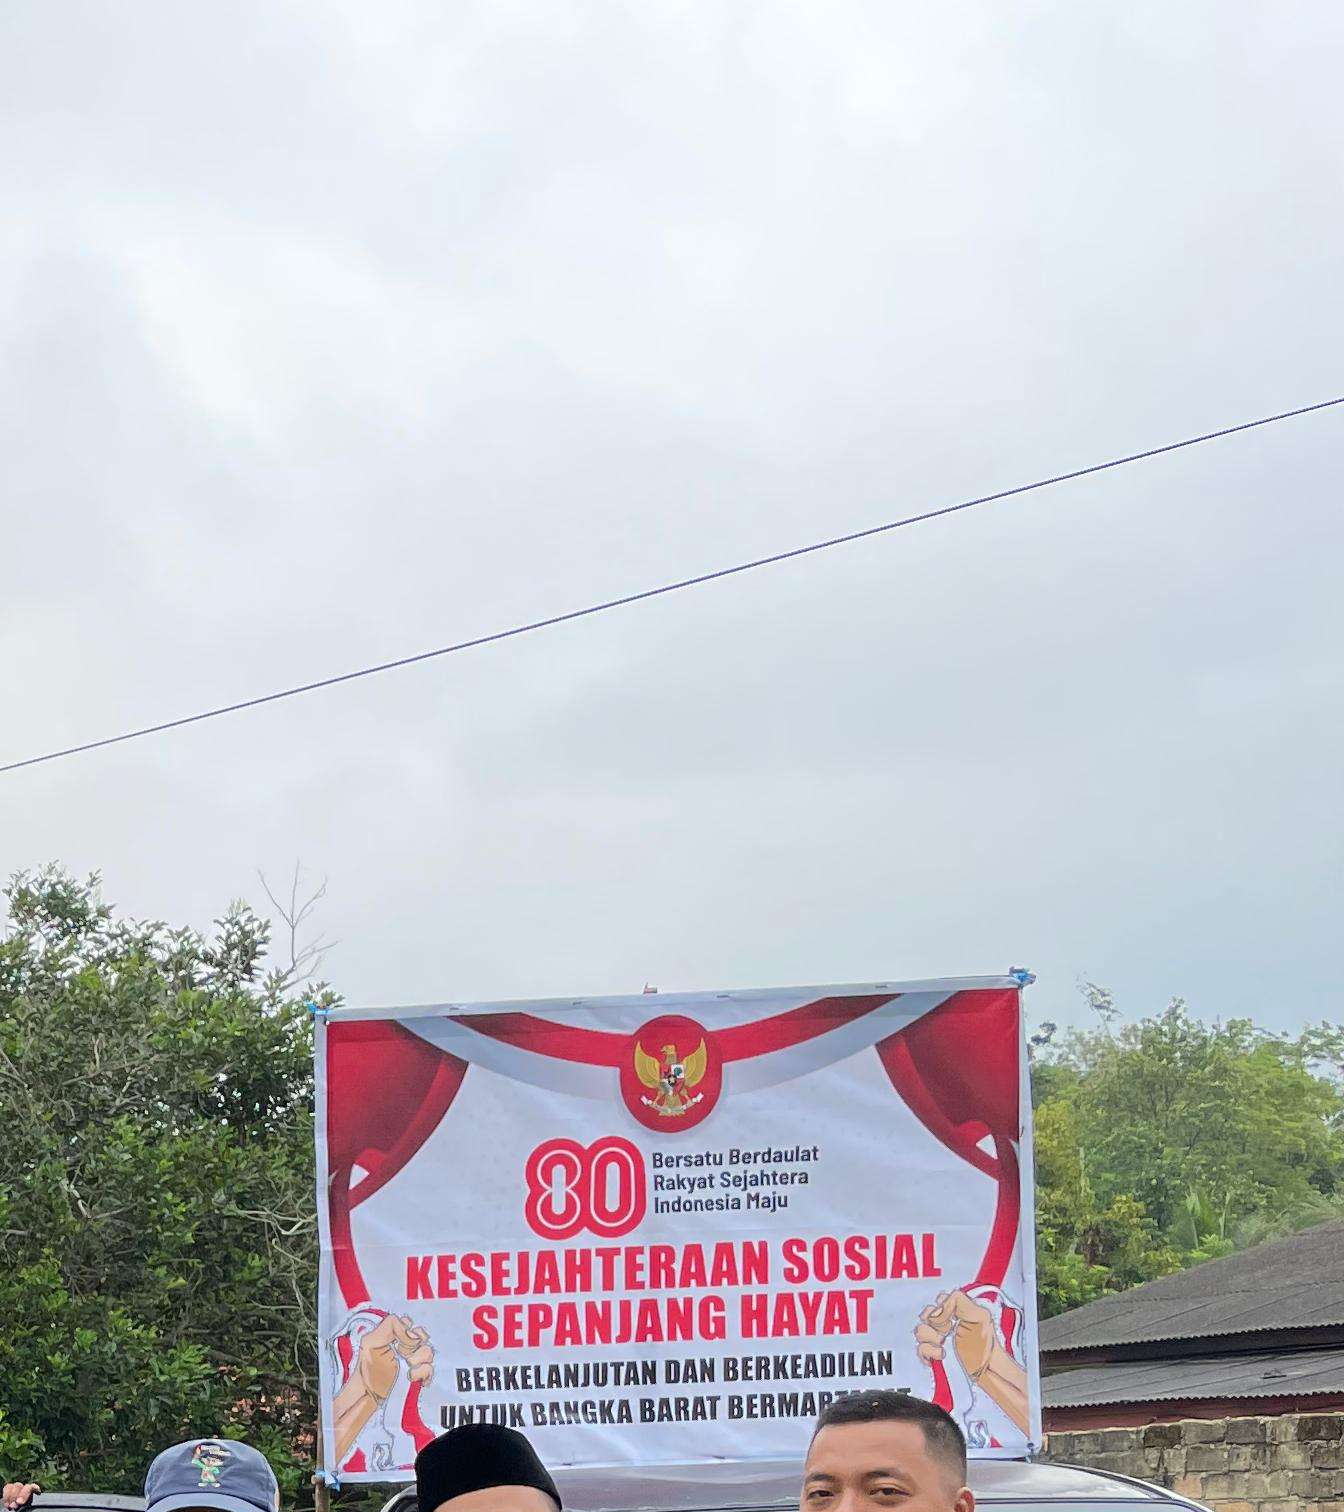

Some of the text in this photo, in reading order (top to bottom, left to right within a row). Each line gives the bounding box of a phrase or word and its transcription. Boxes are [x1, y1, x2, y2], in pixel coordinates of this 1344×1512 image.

[652, 1145, 820, 1169] Bersatu Berdaulat
[525, 1135, 646, 1241] 80
[654, 1169, 809, 1194] Rakyat Sejahtera
[655, 1190, 789, 1214] Indonesia Maju
[406, 1233, 942, 1300] KESEJAHTERAAN SOSIAL
[472, 1289, 875, 1350] SEPANJANG HAYAT
[456, 1350, 893, 1392] BERKELANJUTAN DAN BERKEADILAN
[440, 1402, 526, 1429] UNTUK
[530, 1398, 633, 1426] BANGKA
[639, 1395, 721, 1422] BARAT
